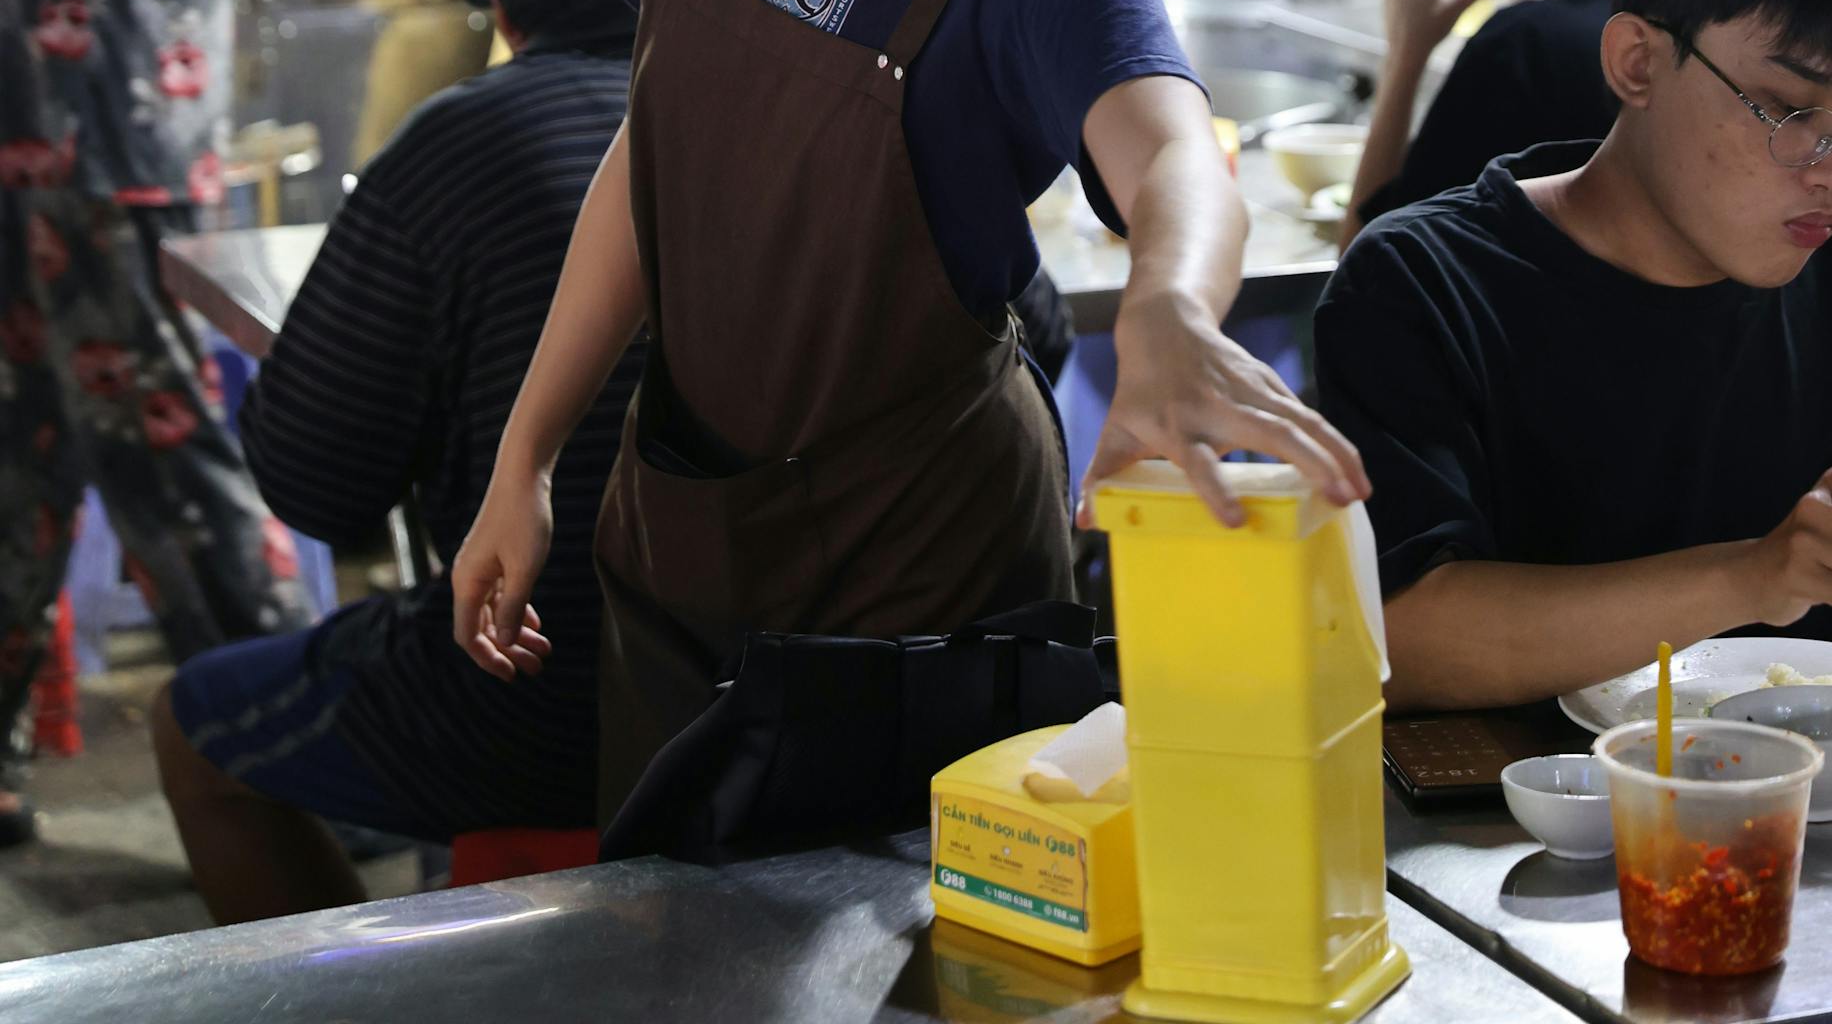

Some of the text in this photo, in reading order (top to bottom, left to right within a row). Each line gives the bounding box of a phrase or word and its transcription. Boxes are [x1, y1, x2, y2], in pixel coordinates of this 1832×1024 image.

[993, 822, 1015, 839] GỌI
[941, 868, 967, 891] F88
[992, 887, 1013, 903] 1800
